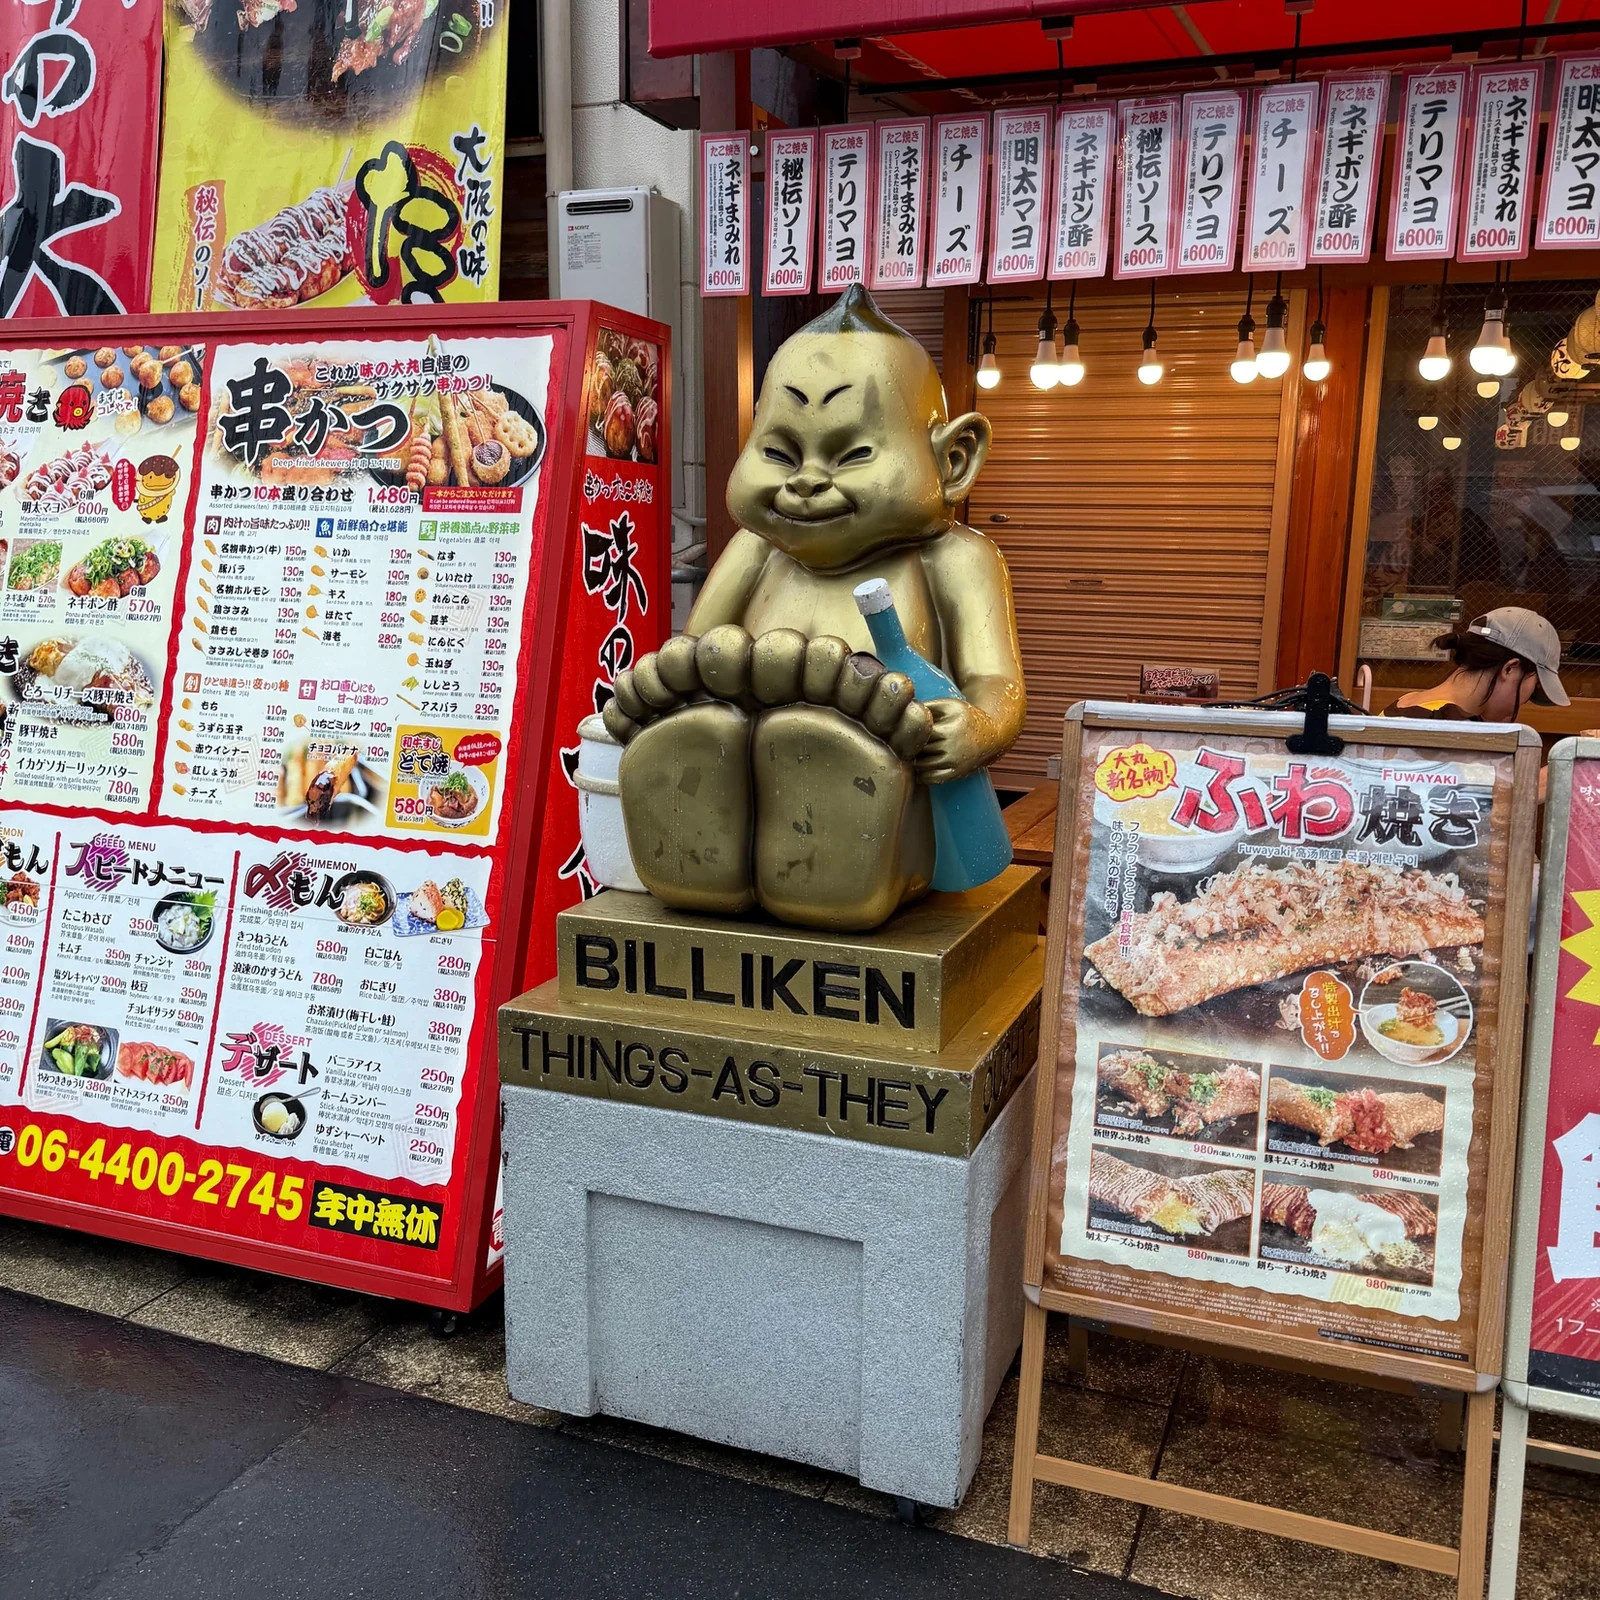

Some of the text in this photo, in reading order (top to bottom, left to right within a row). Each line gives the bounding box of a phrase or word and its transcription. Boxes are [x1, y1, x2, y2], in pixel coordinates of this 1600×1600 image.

[1335, 87, 1375, 102] たこ焼き
[1415, 80, 1457, 95] たこ焼き
[1486, 78, 1529, 94] たこ焼き
[1196, 105, 1235, 120] たこ焼き
[1265, 98, 1305, 114] たこ焼き
[1068, 115, 1104, 129] たこ焼き
[1131, 110, 1168, 125] たこ焼き
[944, 126, 978, 139] たこ焼き
[1006, 120, 1041, 134] たこ焼き
[831, 138, 863, 150] たこ焼き
[886, 130, 919, 144] たこ焼き
[710, 144, 741, 156] たこ焼き
[777, 143, 808, 154] たこ焼き
[1328, 105, 1368, 229] ネギポン酢
[1495, 95, 1527, 222] ネギまみれ
[1265, 118, 1297, 235] チーズ
[1012, 137, 1039, 249] 明太マヨ
[1068, 132, 1099, 247] ネギポン酢
[1134, 127, 1163, 245] 秘伝ソース
[897, 146, 919, 256] ネギまみれ
[946, 144, 972, 253] チーズ
[724, 159, 742, 265] ネギまみれ
[780, 157, 804, 266] 秘伝ソース
[315, 354, 469, 382] これが味の大丸自慢の
[375, 375, 492, 398] サクサク串かつ!
[98, 389, 123, 402] まずは
[217, 357, 411, 466] 串かつ
[317, 459, 350, 469] skewers
[210, 485, 354, 503] 串かつ10本盛り合わせ
[21, 502, 108, 516] 明太マヨ 600円
[336, 519, 408, 534] 新鮮魚介を堪能
[285, 546, 306, 556] 150円
[435, 572, 514, 584] しいたけ 130円
[67, 597, 161, 613] ネギポン酢 570円
[432, 594, 469, 604] れんこん
[114, 707, 147, 723] 680円
[420, 701, 499, 715] アスパラ 230円
[263, 727, 284, 737] 130円
[310, 718, 392, 733] いちごミルク 190円
[19, 725, 144, 748] 豚平焼き 580円
[401, 736, 441, 750] 和牛すじ
[308, 743, 359, 756] チョコバナナ
[1113, 749, 1149, 766] 大丸
[15, 757, 139, 777] イカゲソガーリックバター
[399, 753, 450, 774] どて焼
[1106, 765, 1170, 792] 新名物!
[108, 780, 138, 796] 780円
[190, 787, 276, 803] チーズ 130円
[1170, 747, 1479, 847] ふわ焼き
[394, 798, 433, 816] 580円
[95, 837, 156, 852] SPEED MENU
[1237, 842, 1292, 858] Fuwayaki
[65, 842, 225, 892] スピードメニュー
[299, 857, 357, 872] SHIMEMON
[1106, 821, 1124, 918] 味の大丸の新名物。
[240, 905, 289, 917] Finishing dish
[62, 908, 159, 932] たこわさび 350円
[236, 930, 348, 955] きつねうどん 580円
[58, 942, 131, 961] キムチ 350円
[364, 946, 471, 971] 白ごはん 280円
[134, 953, 212, 973] チャンジャ 380円
[101, 975, 127, 989] 300円
[232, 961, 343, 988] 浪速のかすうどん 780円
[574, 933, 916, 1029] BILLIKEN
[131, 979, 208, 1000] 枝豆 350円
[360, 978, 467, 1004] おにぎり 380円
[428, 1020, 462, 1036] 380円
[264, 1031, 313, 1047] DESSERT
[220, 1030, 319, 1085] デザート
[325, 1067, 346, 1077] Vanilla
[327, 1055, 455, 1085] バニラアイス 250円
[37, 1072, 84, 1089] やみつききゅうり
[218, 1076, 245, 1088] Dessert
[511, 1026, 949, 1134] THINGS-AS-THEY
[112, 1085, 189, 1108] トマトスライス 350円
[321, 1089, 450, 1121] ホームランバー 250円
[316, 1124, 444, 1157] ゆずシャーベット 250円
[1093, 1128, 1151, 1144] 新世界ふわ焼き
[329, 1140, 353, 1150] sherbet
[1264, 1154, 1335, 1172] 豚キムチふわ焼き
[15, 1124, 305, 1222] 06-4400-2745
[314, 1186, 440, 1245] 年中無休
[1257, 1261, 1328, 1280] 餅ちーずふわ焼き
